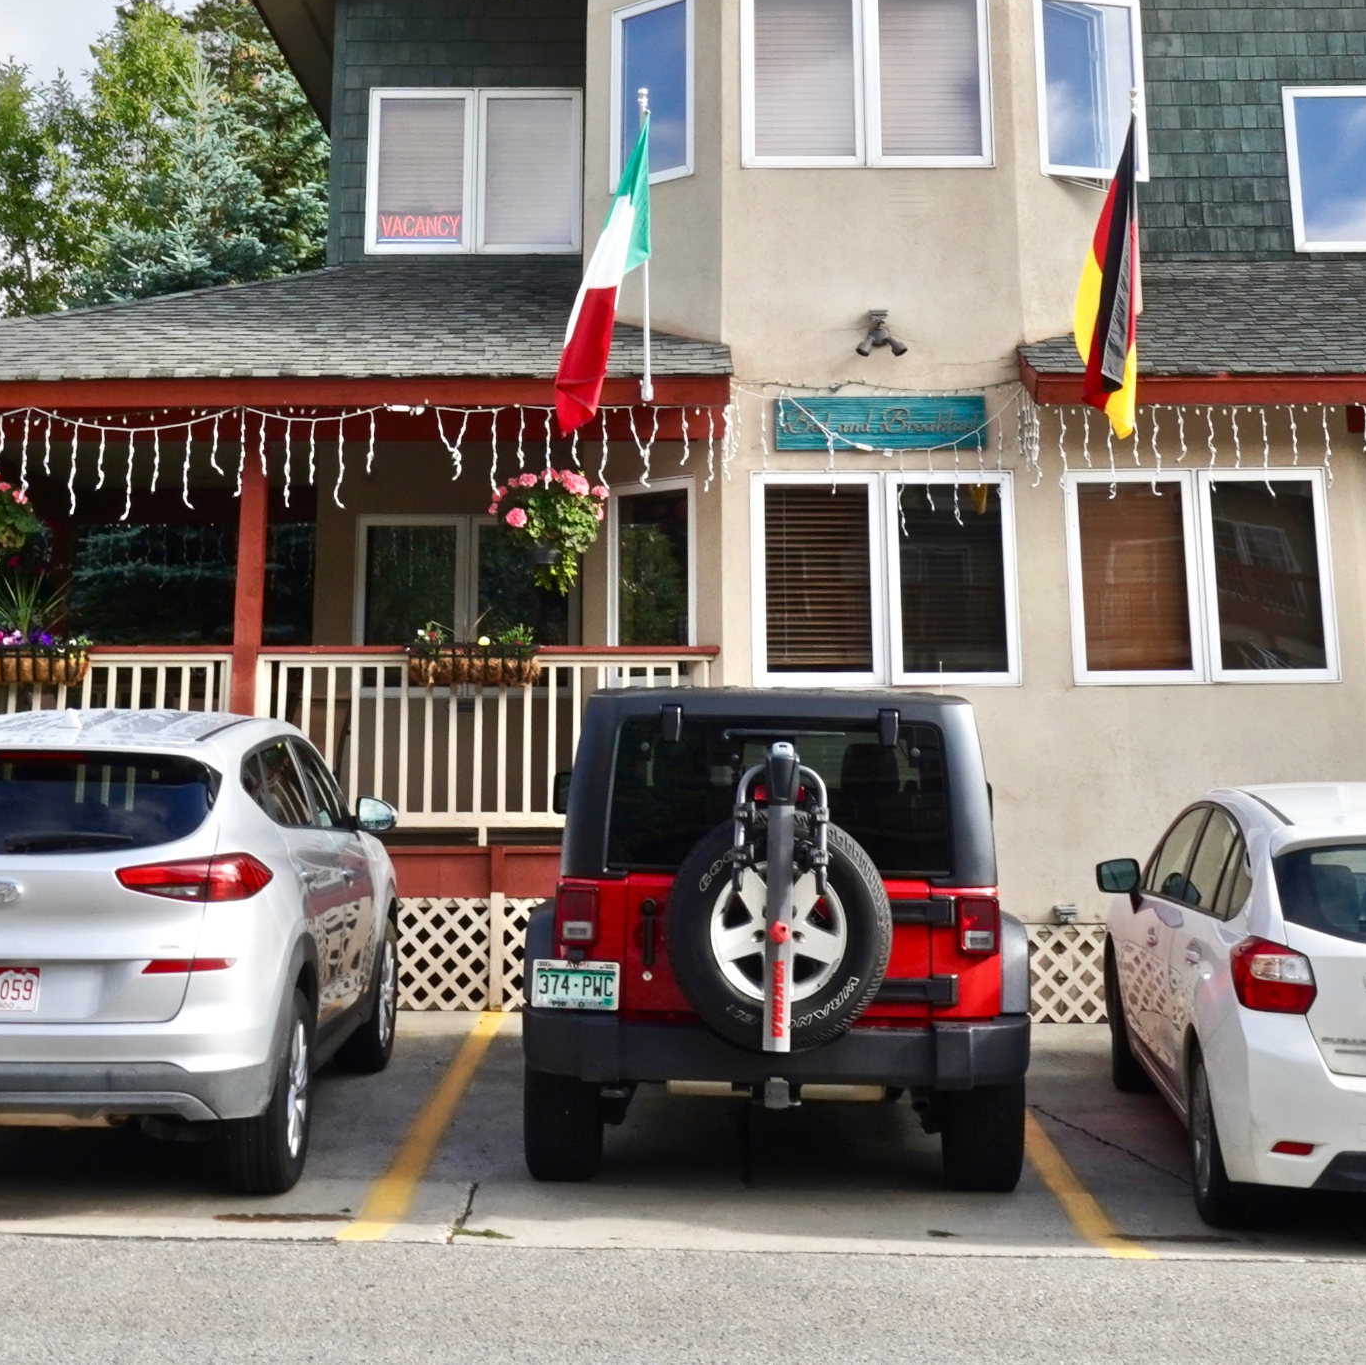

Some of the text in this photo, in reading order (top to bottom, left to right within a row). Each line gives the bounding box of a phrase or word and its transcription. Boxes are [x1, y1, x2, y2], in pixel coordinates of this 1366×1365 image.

[380, 215, 461, 237] VACANCY
[837, 410, 871, 434] and
[771, 960, 785, 1038] YAKIMA
